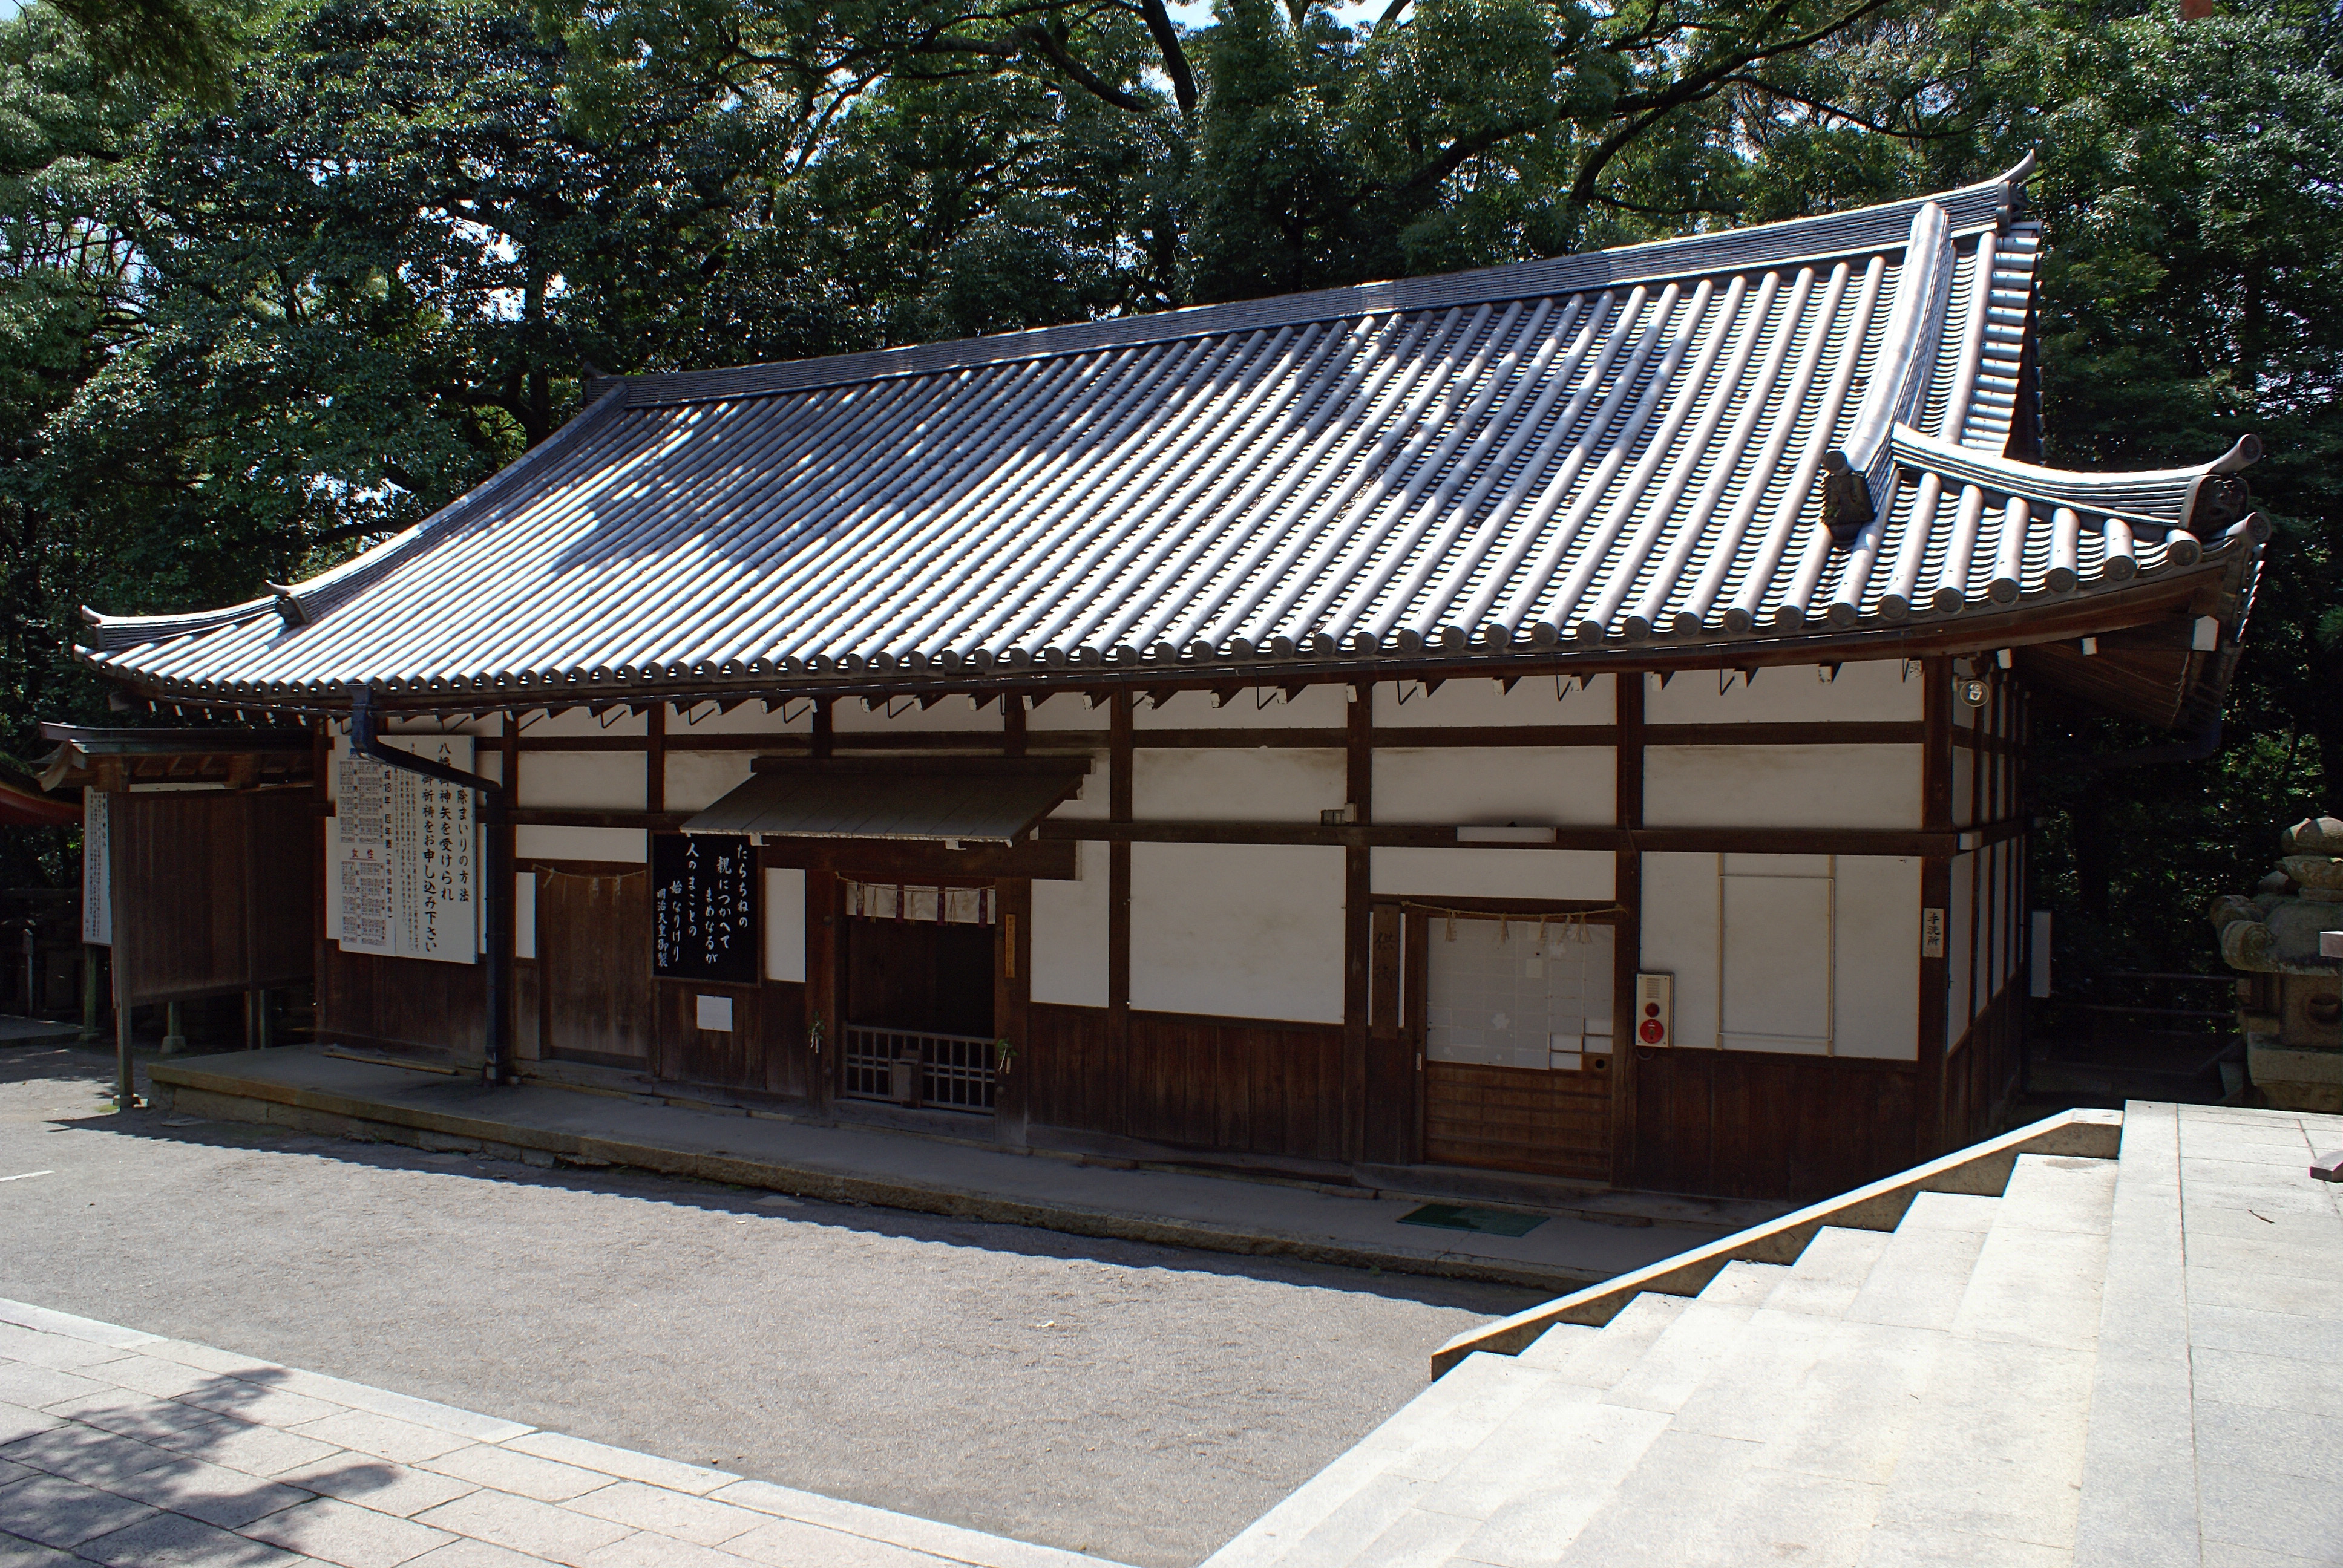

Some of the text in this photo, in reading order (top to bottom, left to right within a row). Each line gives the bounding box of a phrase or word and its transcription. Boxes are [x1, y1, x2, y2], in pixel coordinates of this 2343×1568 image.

[457, 785, 469, 902] 除まいりの方法
[737, 844, 749, 928] たらちねの
[657, 888, 669, 968] 明治天皇御製
[686, 842, 699, 937] 人のまことの
[705, 887, 719, 964] まめなるが
[717, 856, 732, 949] 親につかへて
